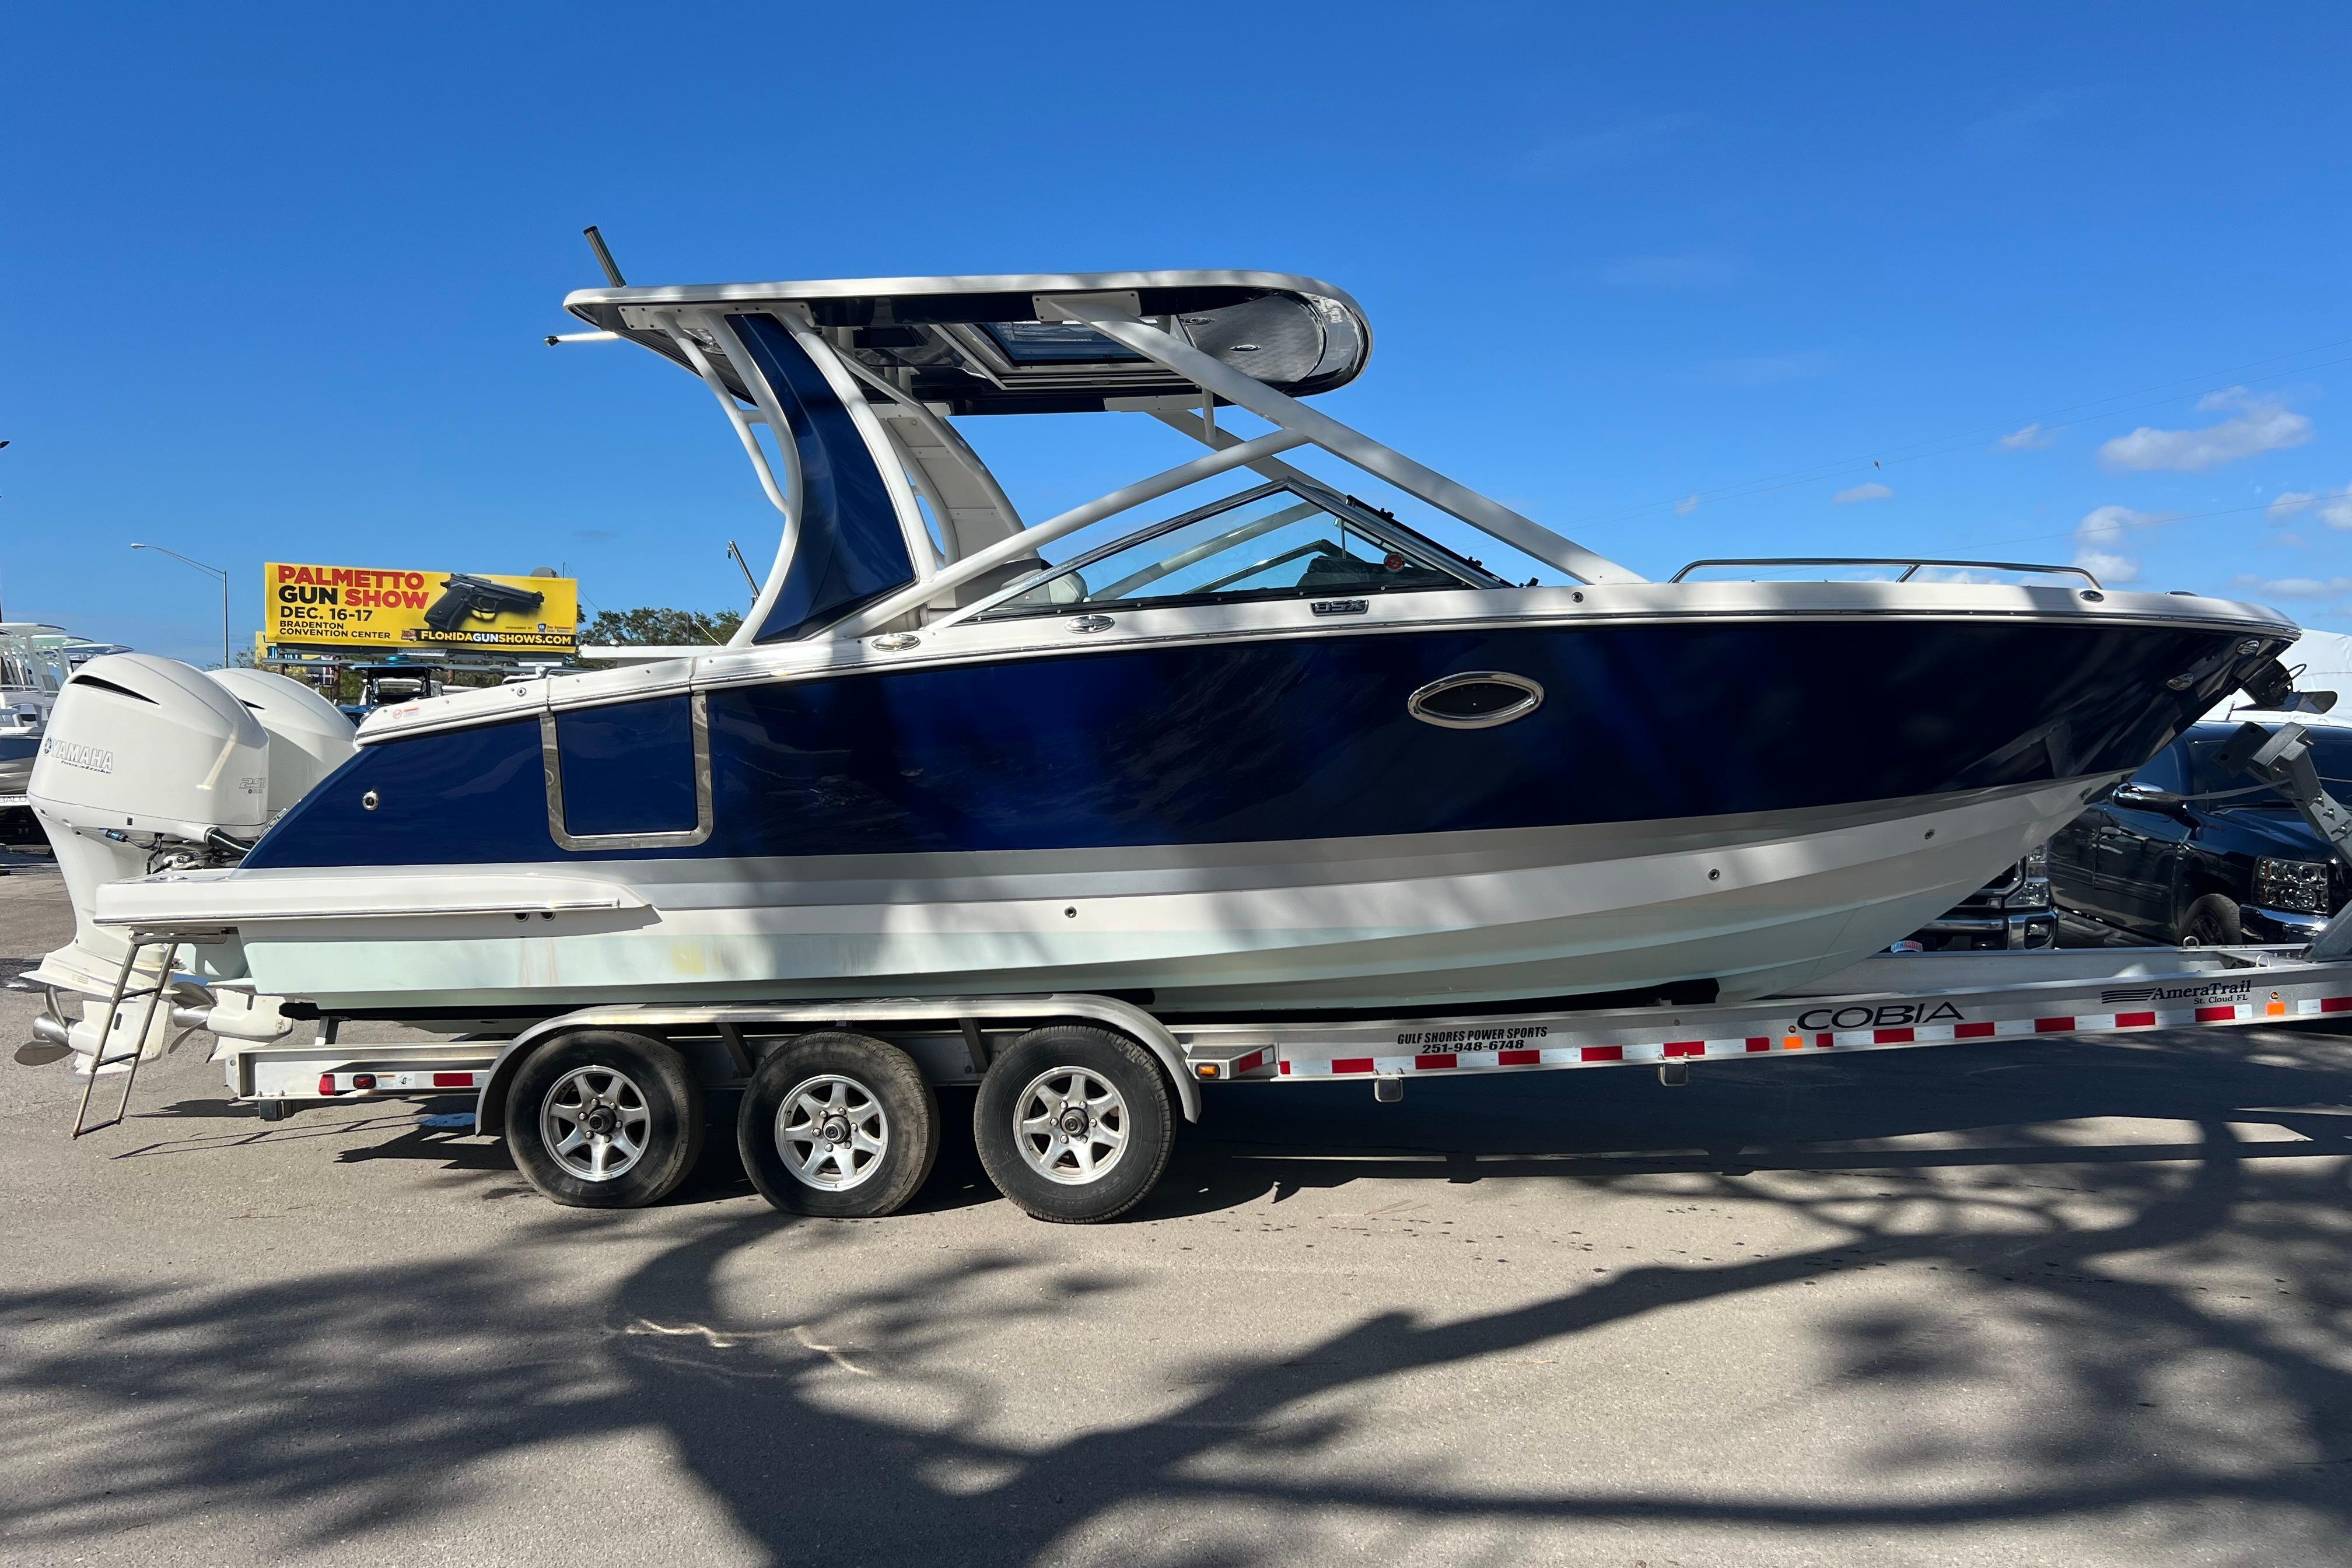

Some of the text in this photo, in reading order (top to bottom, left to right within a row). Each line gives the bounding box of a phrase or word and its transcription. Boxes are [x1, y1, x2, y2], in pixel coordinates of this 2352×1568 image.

[278, 565, 425, 590] PALMETTO
[278, 585, 429, 610] GUN SHOW
[281, 606, 373, 622] DEC. 16-17
[279, 620, 344, 630] BRADENTON
[279, 628, 348, 638] CONVENTION
[351, 631, 391, 639] CENTER
[421, 630, 572, 645] FLORIDAGUNSHOWS.COM
[51, 738, 113, 771] YAMAHA
[2151, 979, 2251, 1000] AmeraTrail
[2208, 995, 2233, 1003] Cloud
[1797, 1002, 1965, 1031] COBIA
[1397, 1026, 1548, 1044] GULF SHORES POWER SPORTS
[1422, 1039, 1524, 1054] 251-948-6748
